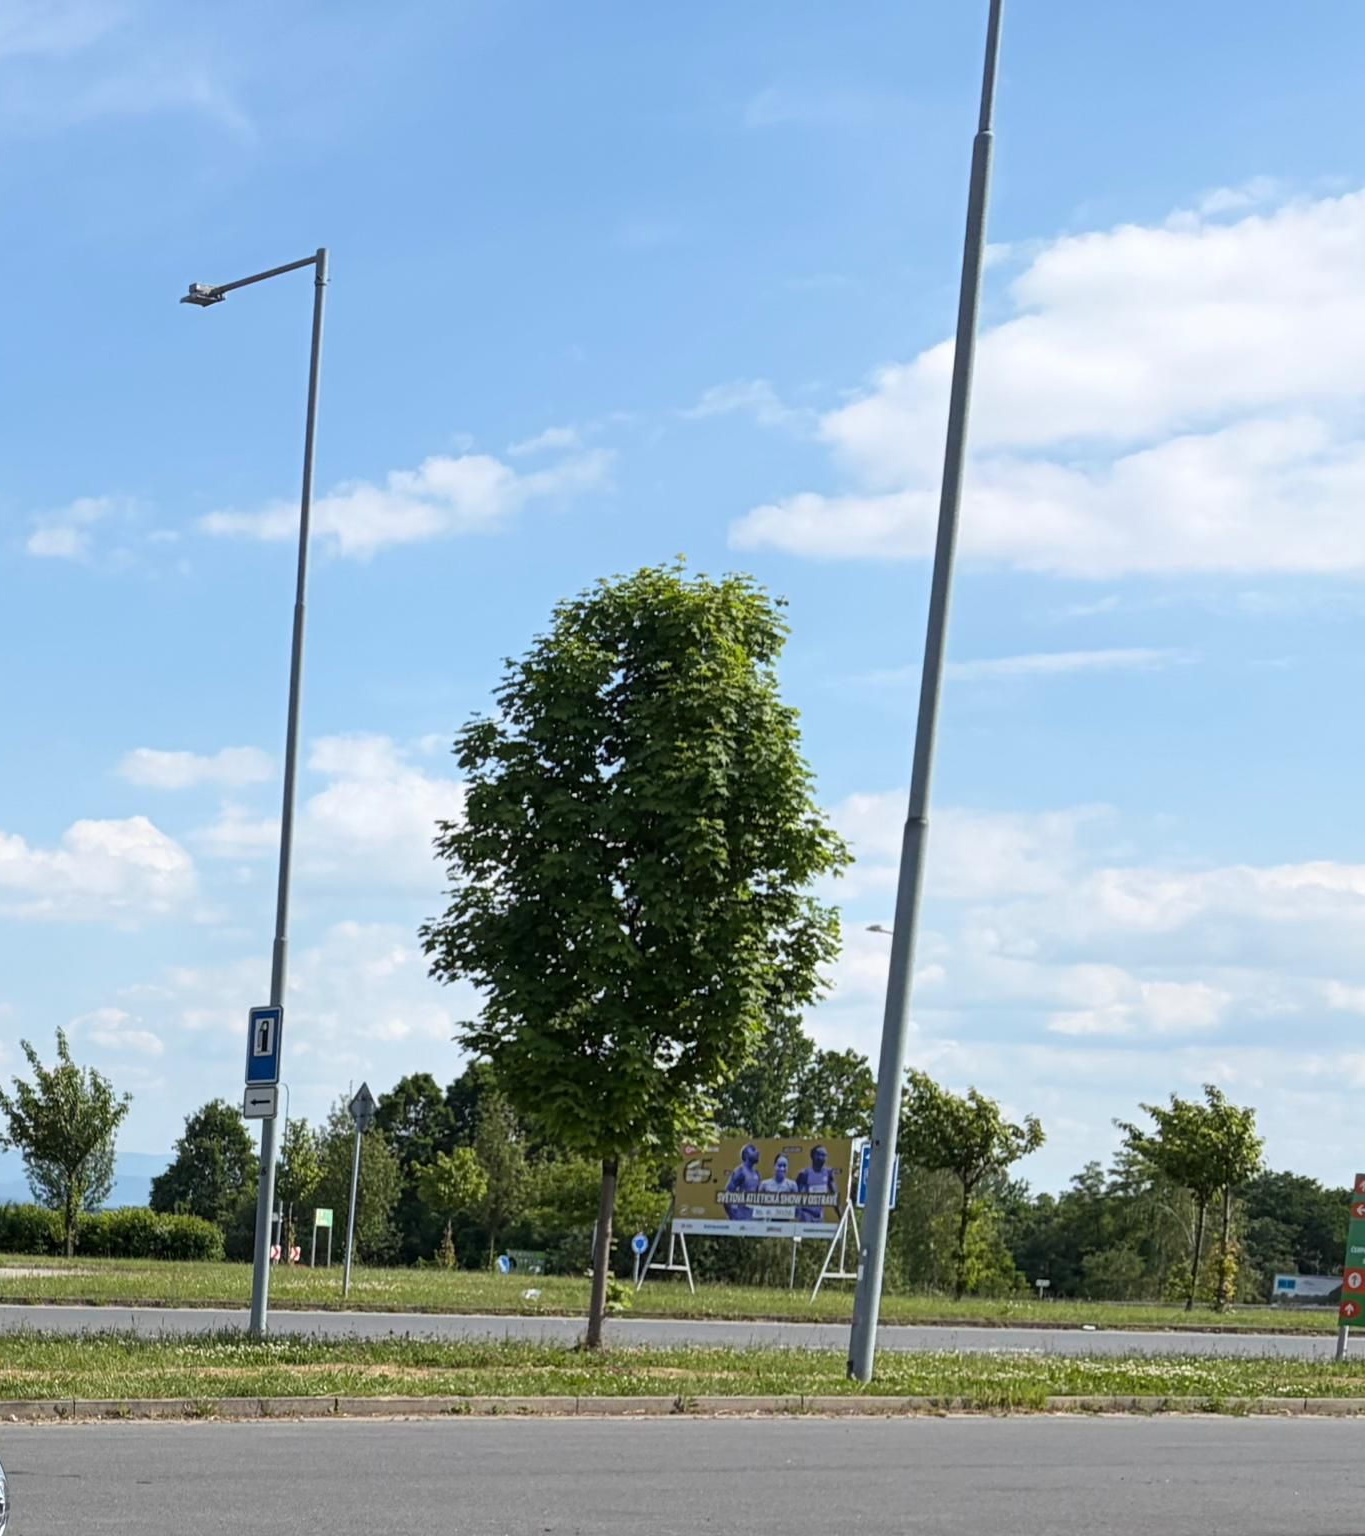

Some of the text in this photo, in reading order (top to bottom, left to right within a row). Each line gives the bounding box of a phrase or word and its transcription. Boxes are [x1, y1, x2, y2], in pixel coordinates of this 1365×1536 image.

[716, 1190, 837, 1206] SVĚTOVÁ ATLETICKÁ SHOW V OSTRAVĚ
